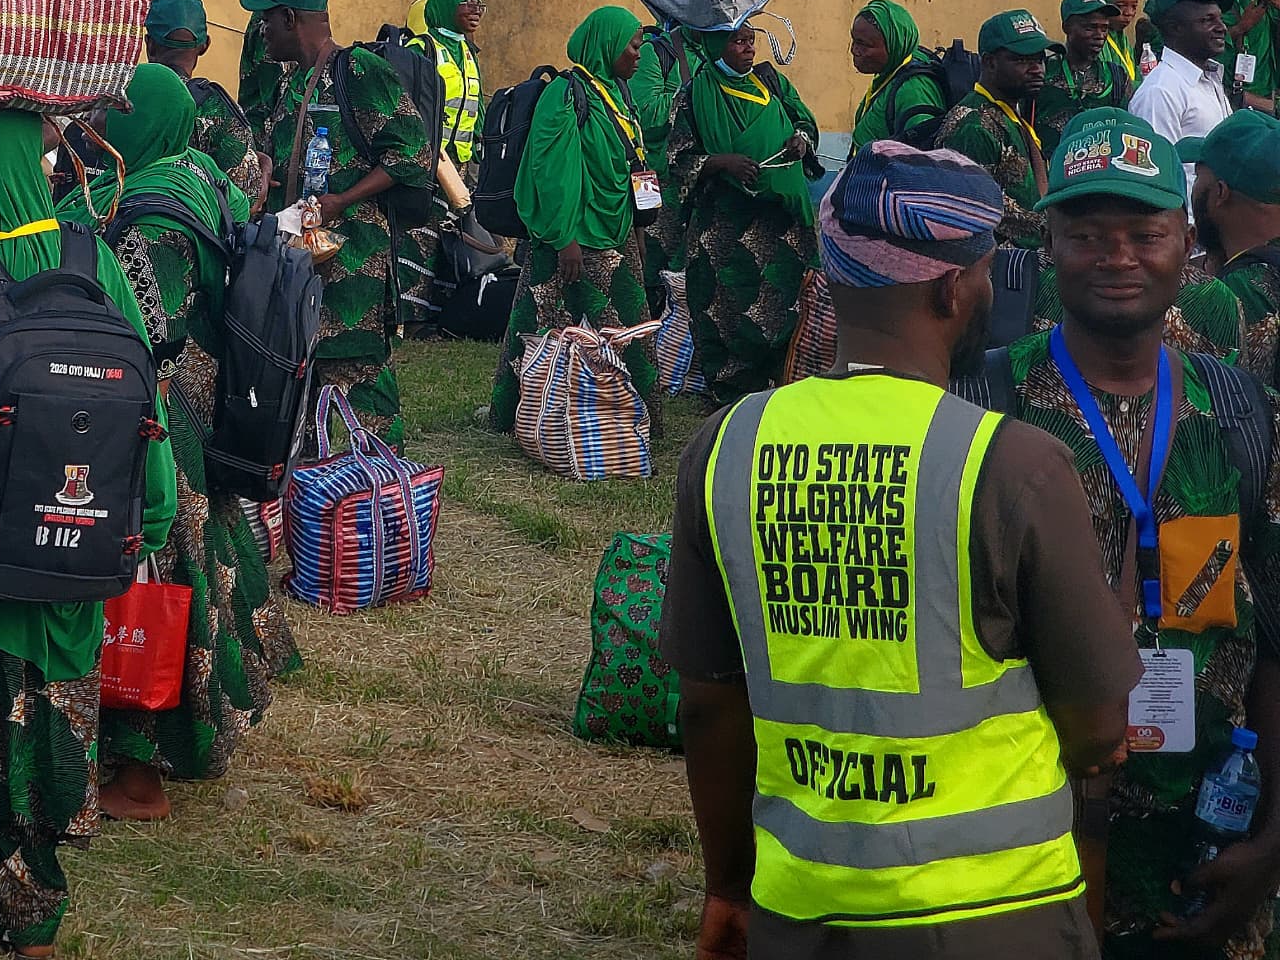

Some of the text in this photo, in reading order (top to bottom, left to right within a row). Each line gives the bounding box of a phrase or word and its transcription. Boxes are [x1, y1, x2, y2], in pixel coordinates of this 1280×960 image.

[1064, 143, 1111, 165] 2026
[49, 362, 68, 374] 2026
[69, 365, 83, 376] OYO
[84, 366, 101, 378] HAJJ
[758, 444, 911, 484] OYO STATE
[756, 483, 906, 525] PILGRIMS
[757, 523, 908, 567] WELFARE
[762, 564, 909, 609] BOARD
[768, 603, 908, 642] MUSLIM WING
